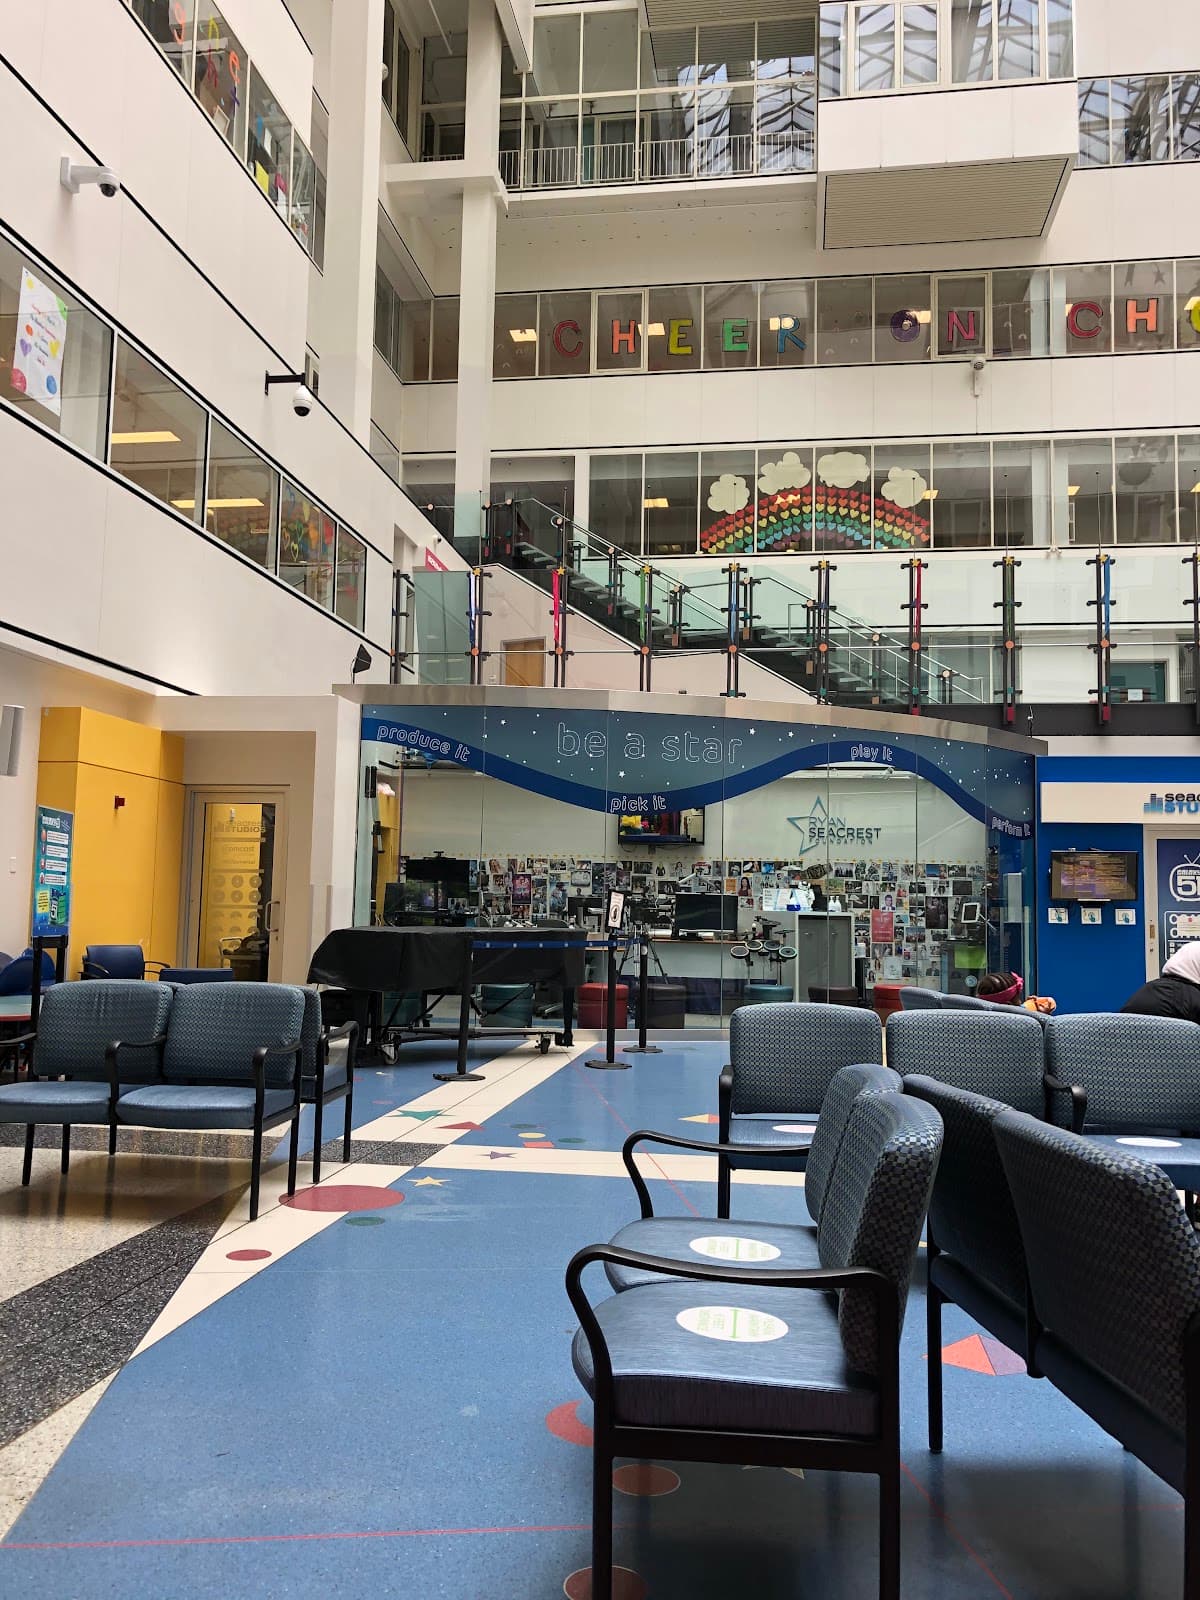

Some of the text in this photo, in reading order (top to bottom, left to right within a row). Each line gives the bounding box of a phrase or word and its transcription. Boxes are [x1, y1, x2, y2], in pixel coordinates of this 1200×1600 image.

[553, 313, 807, 359] CHEER
[890, 308, 975, 343] ON
[377, 725, 471, 762] produce it
[557, 722, 743, 764] be a star
[850, 743, 893, 762] play it
[610, 794, 667, 814] pick it
[1164, 801, 1199, 814] STU
[808, 816, 847, 828] RYAN
[991, 816, 1023, 837] perform
[808, 827, 882, 840] SEACREST
[808, 838, 874, 846] FOUNDATION
[1176, 875, 1200, 896] 5
